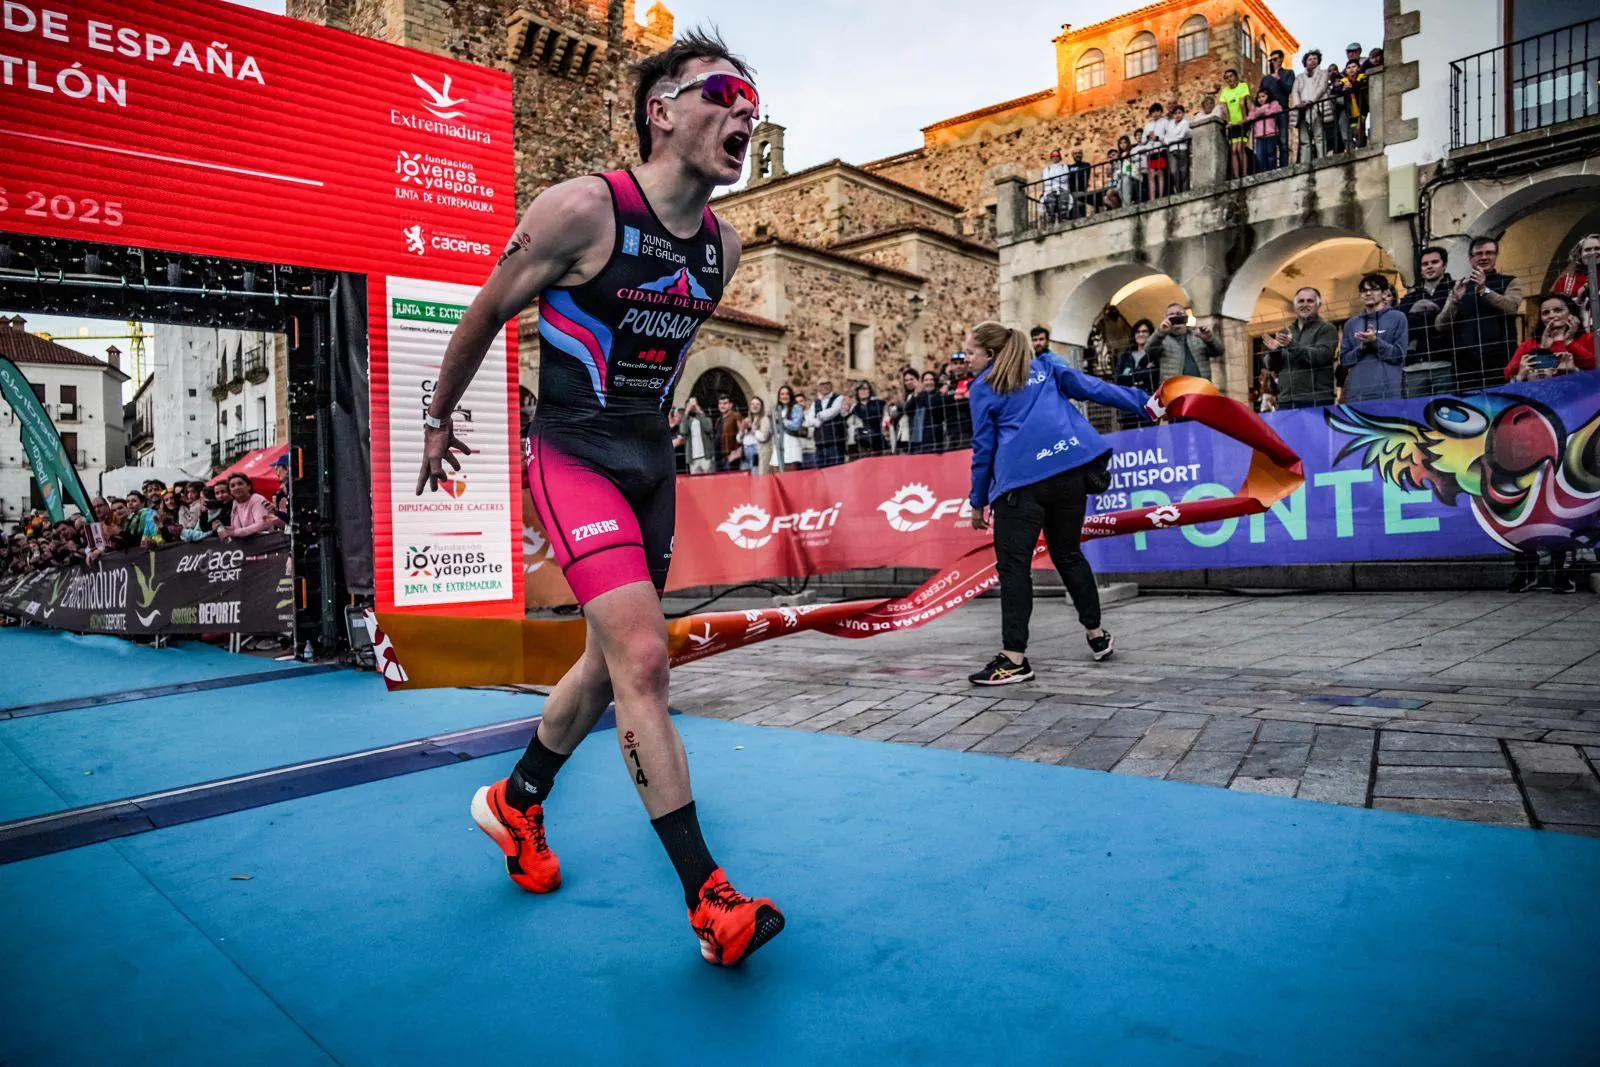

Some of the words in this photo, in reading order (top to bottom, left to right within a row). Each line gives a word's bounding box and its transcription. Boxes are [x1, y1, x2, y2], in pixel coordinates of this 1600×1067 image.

[3, 0, 70, 43] DE
[88, 19, 265, 86] ESPAÑA
[390, 109, 491, 144] Extremadura
[425, 154, 474, 170] fundación
[25, 191, 124, 227] 2025
[395, 187, 419, 200] JUNTA
[423, 193, 433, 203] DE
[437, 194, 494, 213] EXTREMADURA
[643, 233, 672, 251] XUNTA
[642, 244, 653, 256] DE
[655, 248, 687, 264] GALICIA
[616, 287, 670, 305] CIDADE
[674, 296, 690, 308] DE
[395, 303, 421, 315] JUNTA
[425, 306, 436, 318] DE
[618, 308, 699, 339] POUSADA
[398, 503, 452, 512] DIPUTACIÓN
[1095, 492, 1128, 511] 2025
[571, 519, 620, 542] 226ERS
[208, 568, 242, 583] SPORT
[404, 584, 429, 596] JUNTA
[432, 583, 442, 593] DE
[446, 580, 503, 592] EXTREMADURA
[914, 570, 961, 606] CÁCERES
[887, 601, 914, 612] 2025
[945, 595, 963, 609] DE
[198, 601, 241, 625] DEPORTE
[892, 606, 945, 628] ESPAÑA
[872, 622, 891, 631] DE
